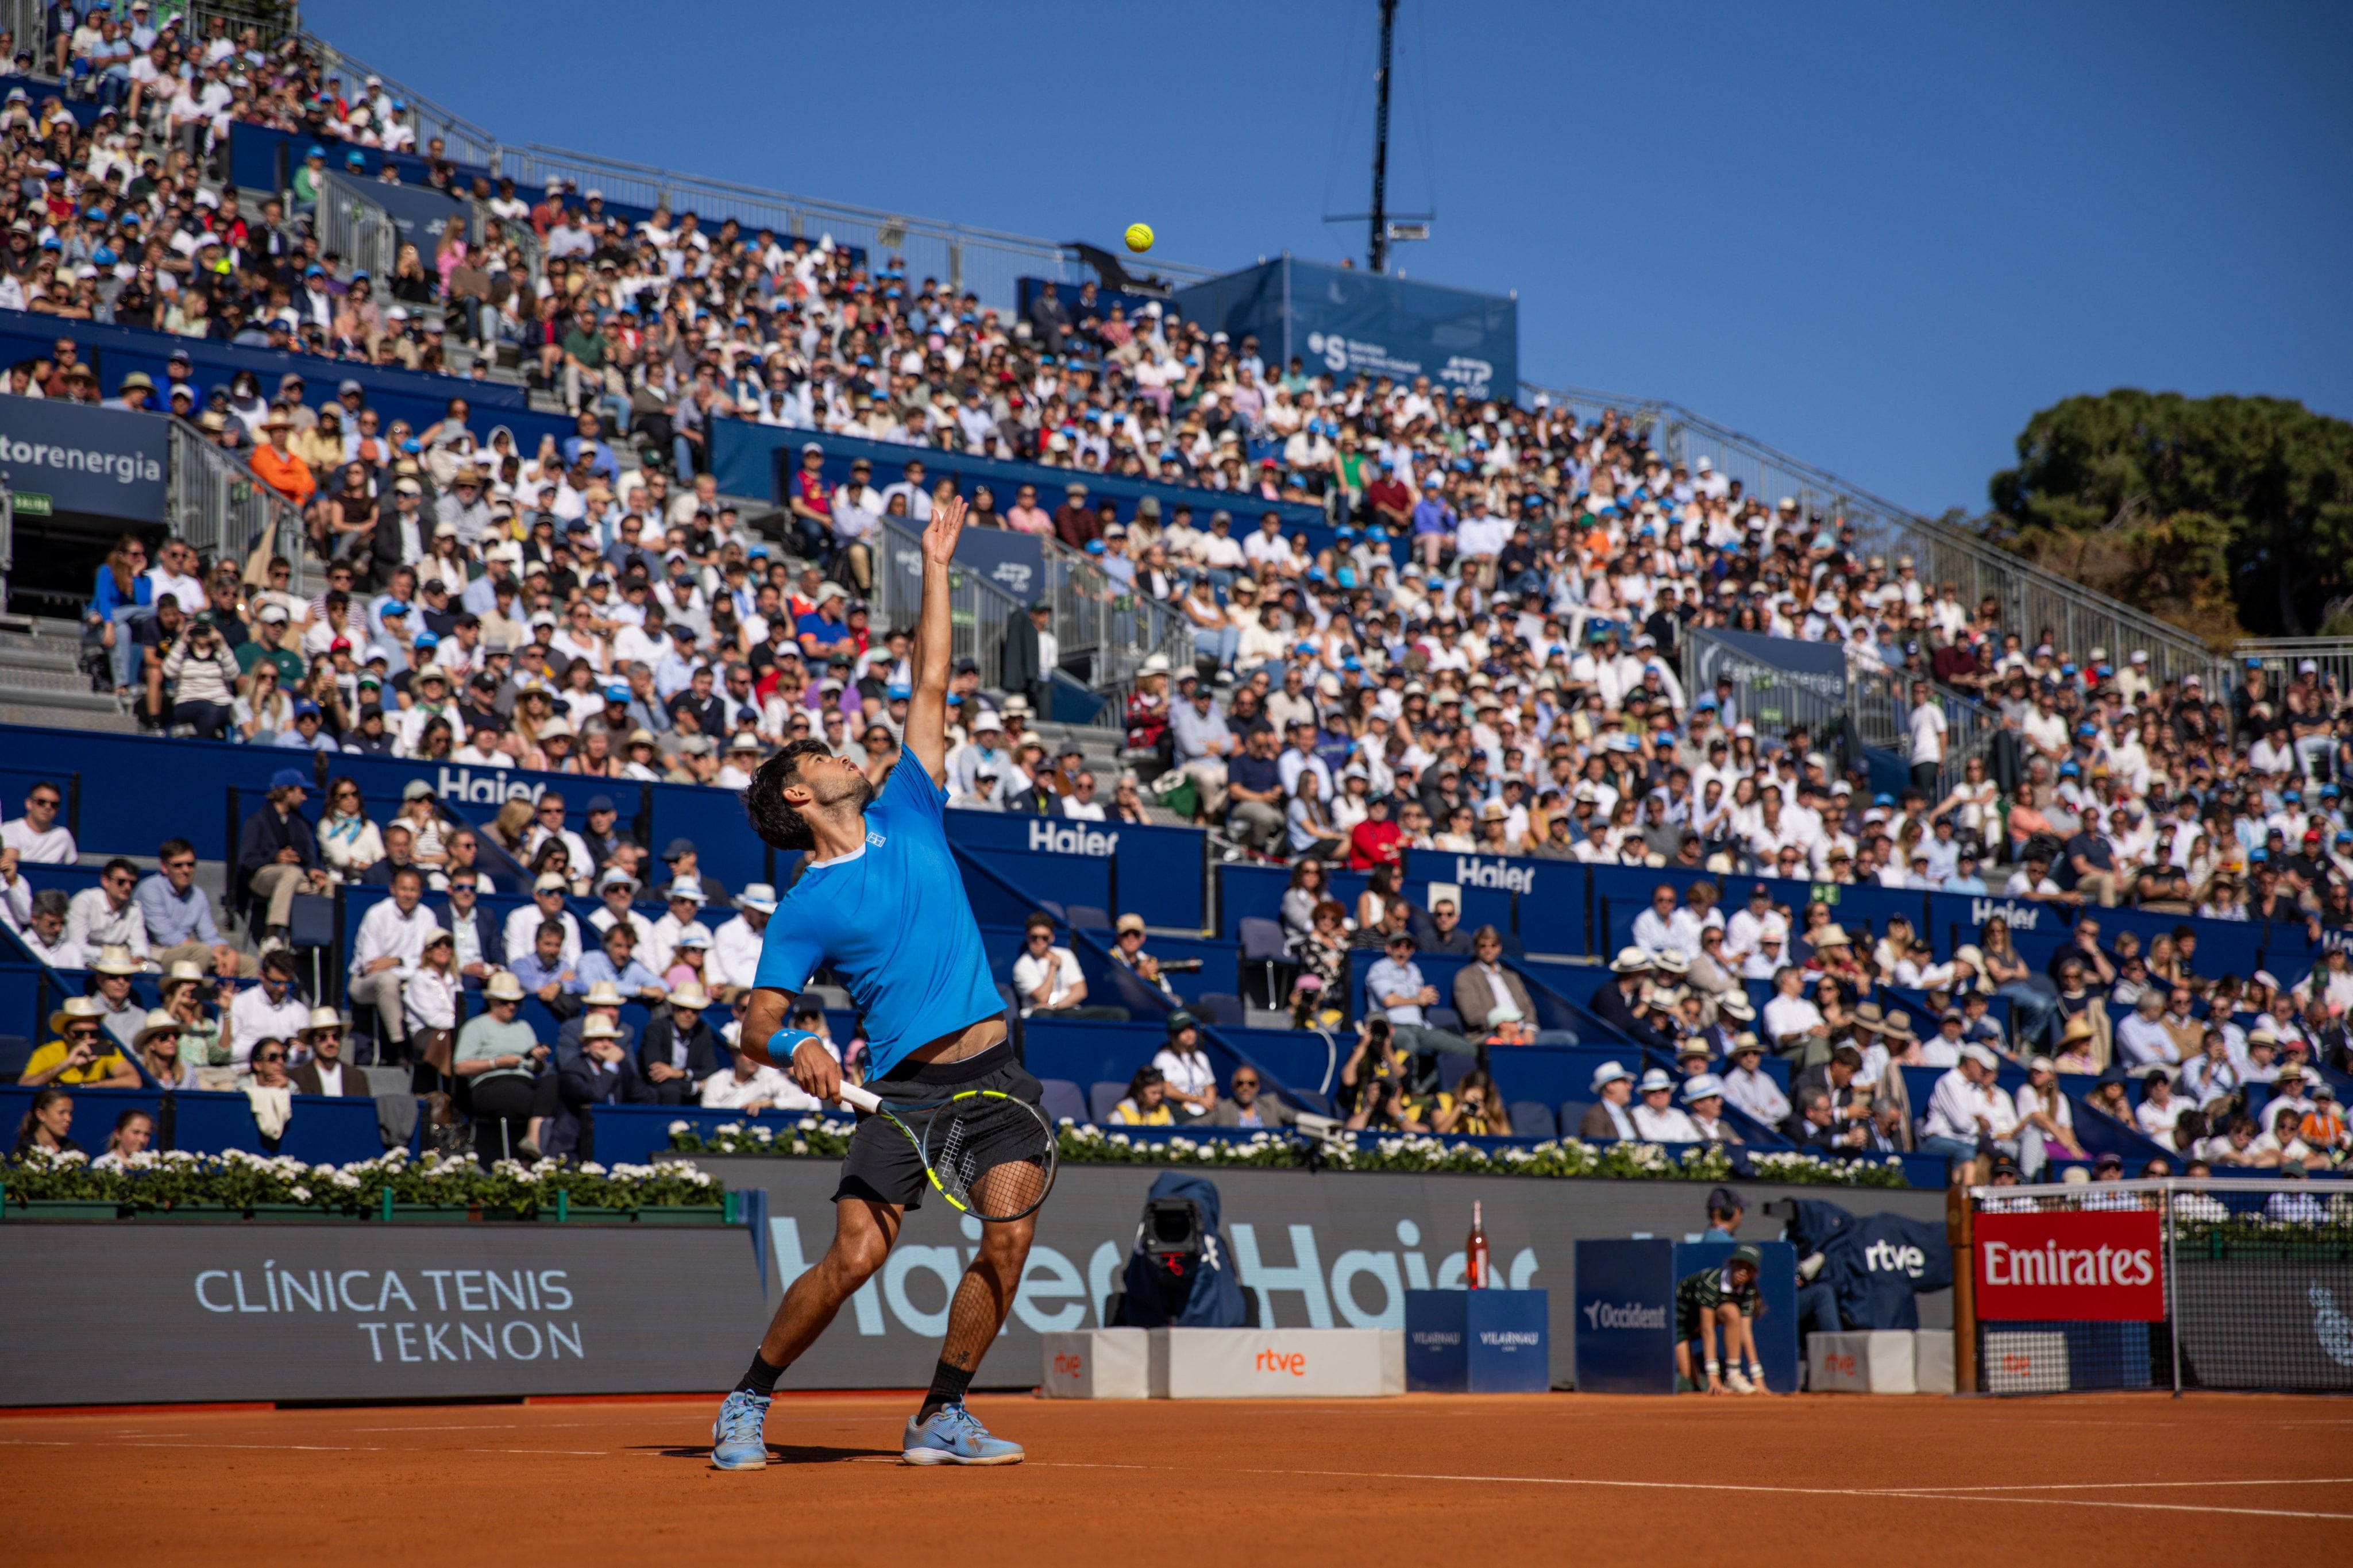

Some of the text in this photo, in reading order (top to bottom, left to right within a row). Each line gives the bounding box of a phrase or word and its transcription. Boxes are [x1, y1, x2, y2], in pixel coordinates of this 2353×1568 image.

[1438, 355, 1493, 385] ATP
[0, 434, 161, 484] torenergia
[438, 766, 546, 806] Haier
[1028, 818, 1119, 857] Haier
[1456, 855, 1536, 895] Haier
[1972, 897, 2039, 930] Haier
[1865, 1238, 1926, 1279] rtve
[1982, 1238, 2154, 1287] Emirates
[194, 1259, 573, 1313] CLÍNICA TENIS
[1600, 1301, 1667, 1330] Occident
[357, 1320, 585, 1362] TEKNON
[1480, 1331, 1539, 1346] VILARNAU
[1256, 1347, 1306, 1377] rtve
